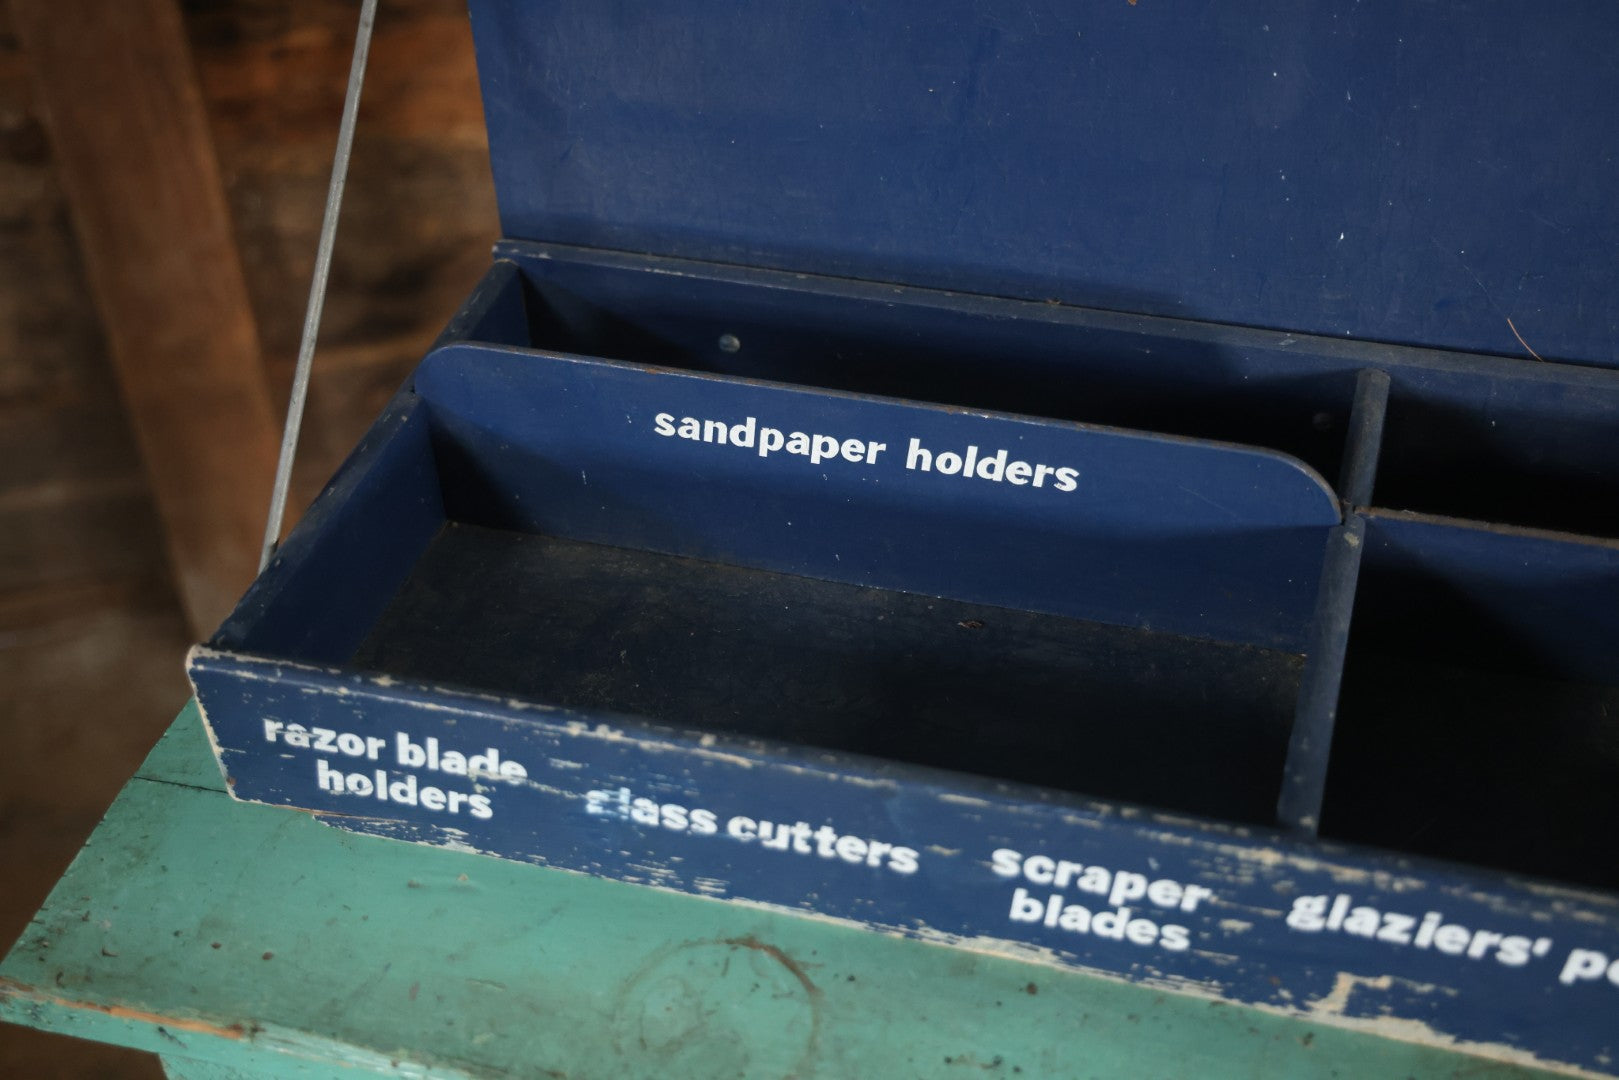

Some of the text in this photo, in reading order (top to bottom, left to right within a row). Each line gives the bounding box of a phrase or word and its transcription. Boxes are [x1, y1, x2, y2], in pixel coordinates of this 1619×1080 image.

[654, 412, 1080, 492] sandpaper holders
[263, 718, 528, 785] razor blade
[317, 759, 493, 820] holders
[727, 815, 920, 874] cutters
[991, 848, 1210, 912] scraper
[1009, 888, 1190, 951] blades
[1287, 894, 1552, 966] glaziers'
